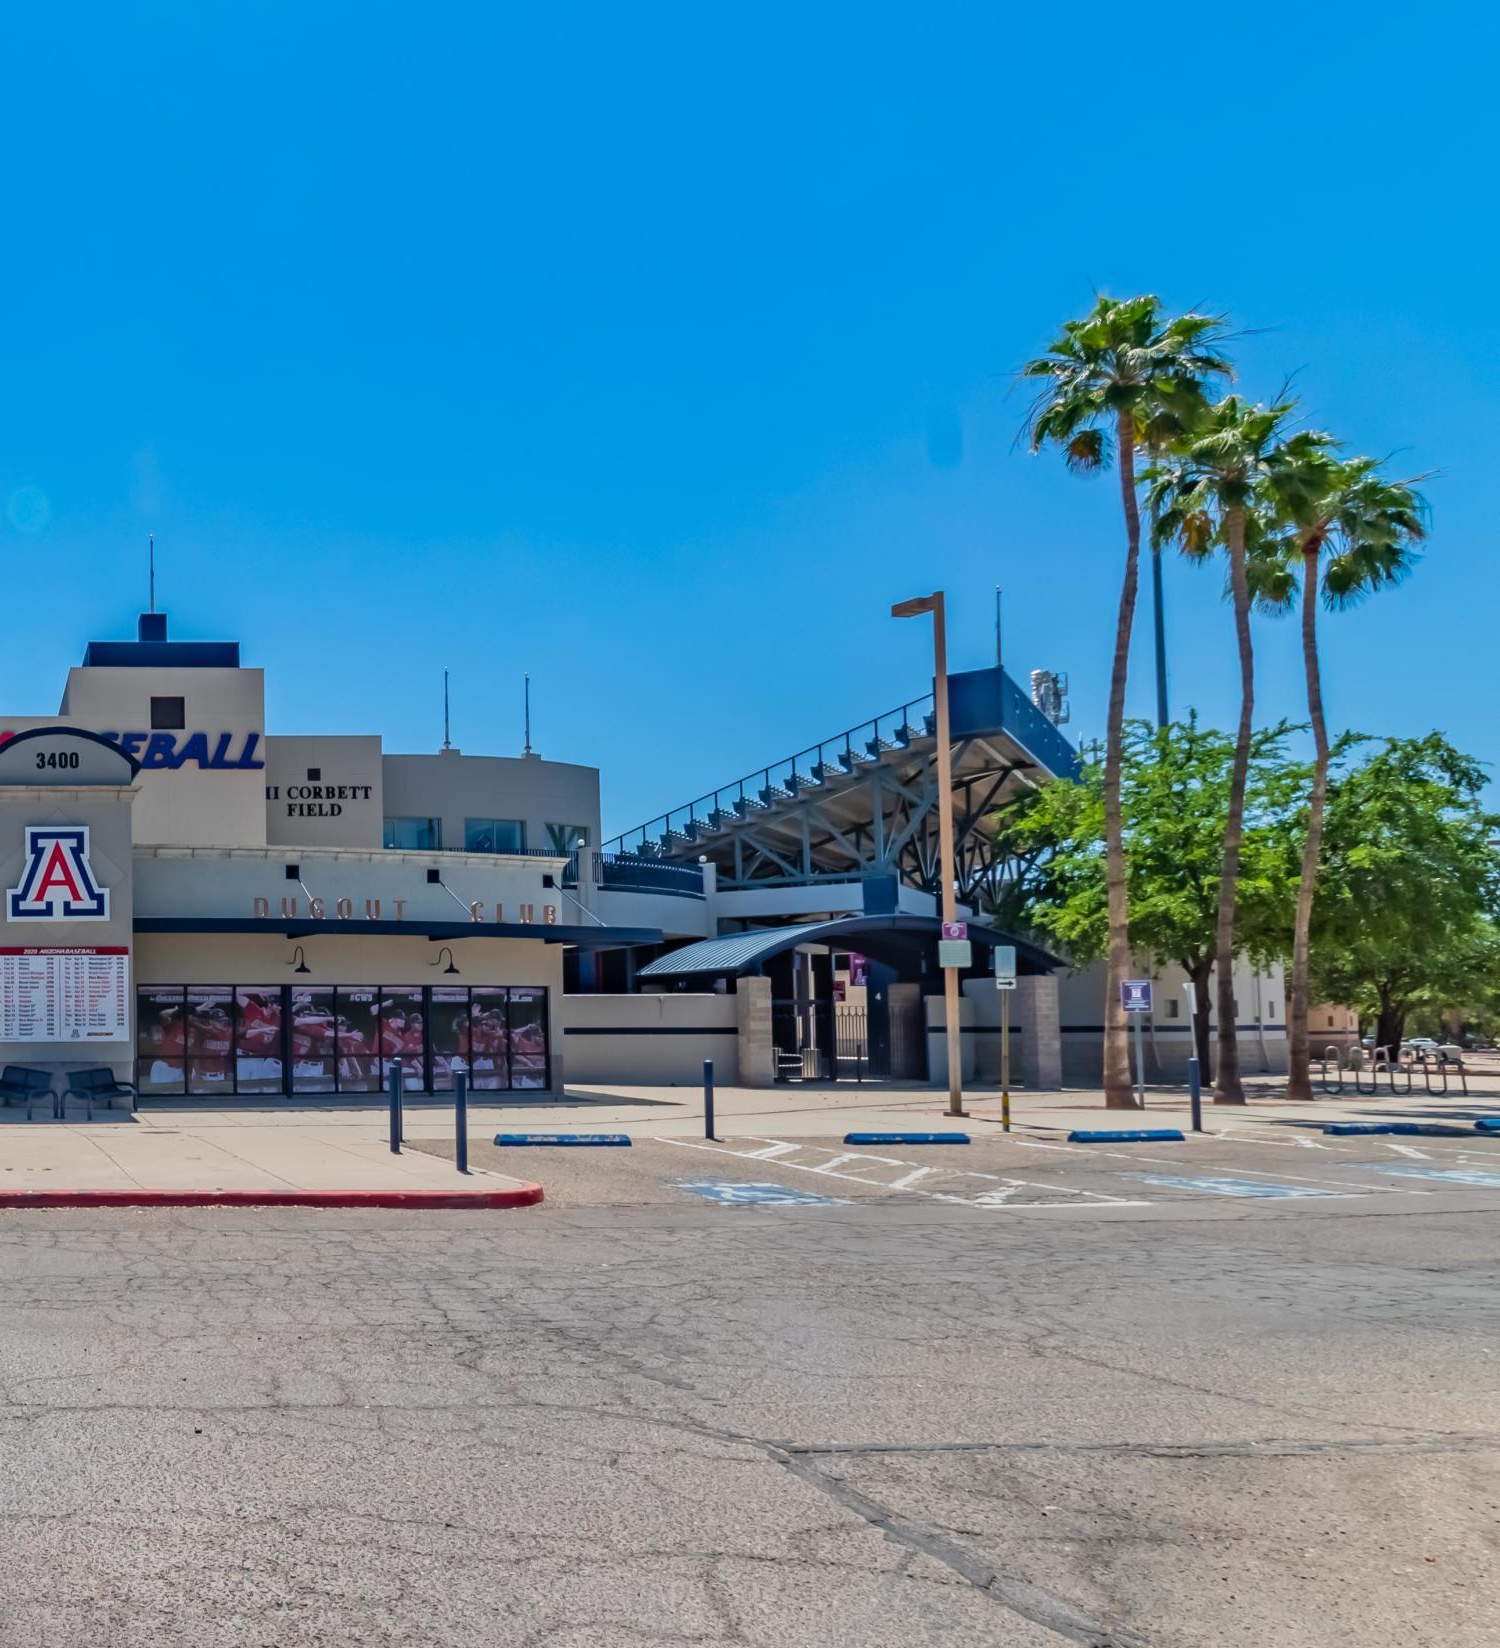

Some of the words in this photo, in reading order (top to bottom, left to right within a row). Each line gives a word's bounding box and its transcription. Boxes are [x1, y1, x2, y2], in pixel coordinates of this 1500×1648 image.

[36, 752, 79, 769] 3400
[287, 786, 372, 800] CORBETT
[287, 804, 342, 816] FIELD
[7, 826, 110, 922] A
[253, 897, 408, 920] DUGOUT
[471, 901, 556, 925] CLUB
